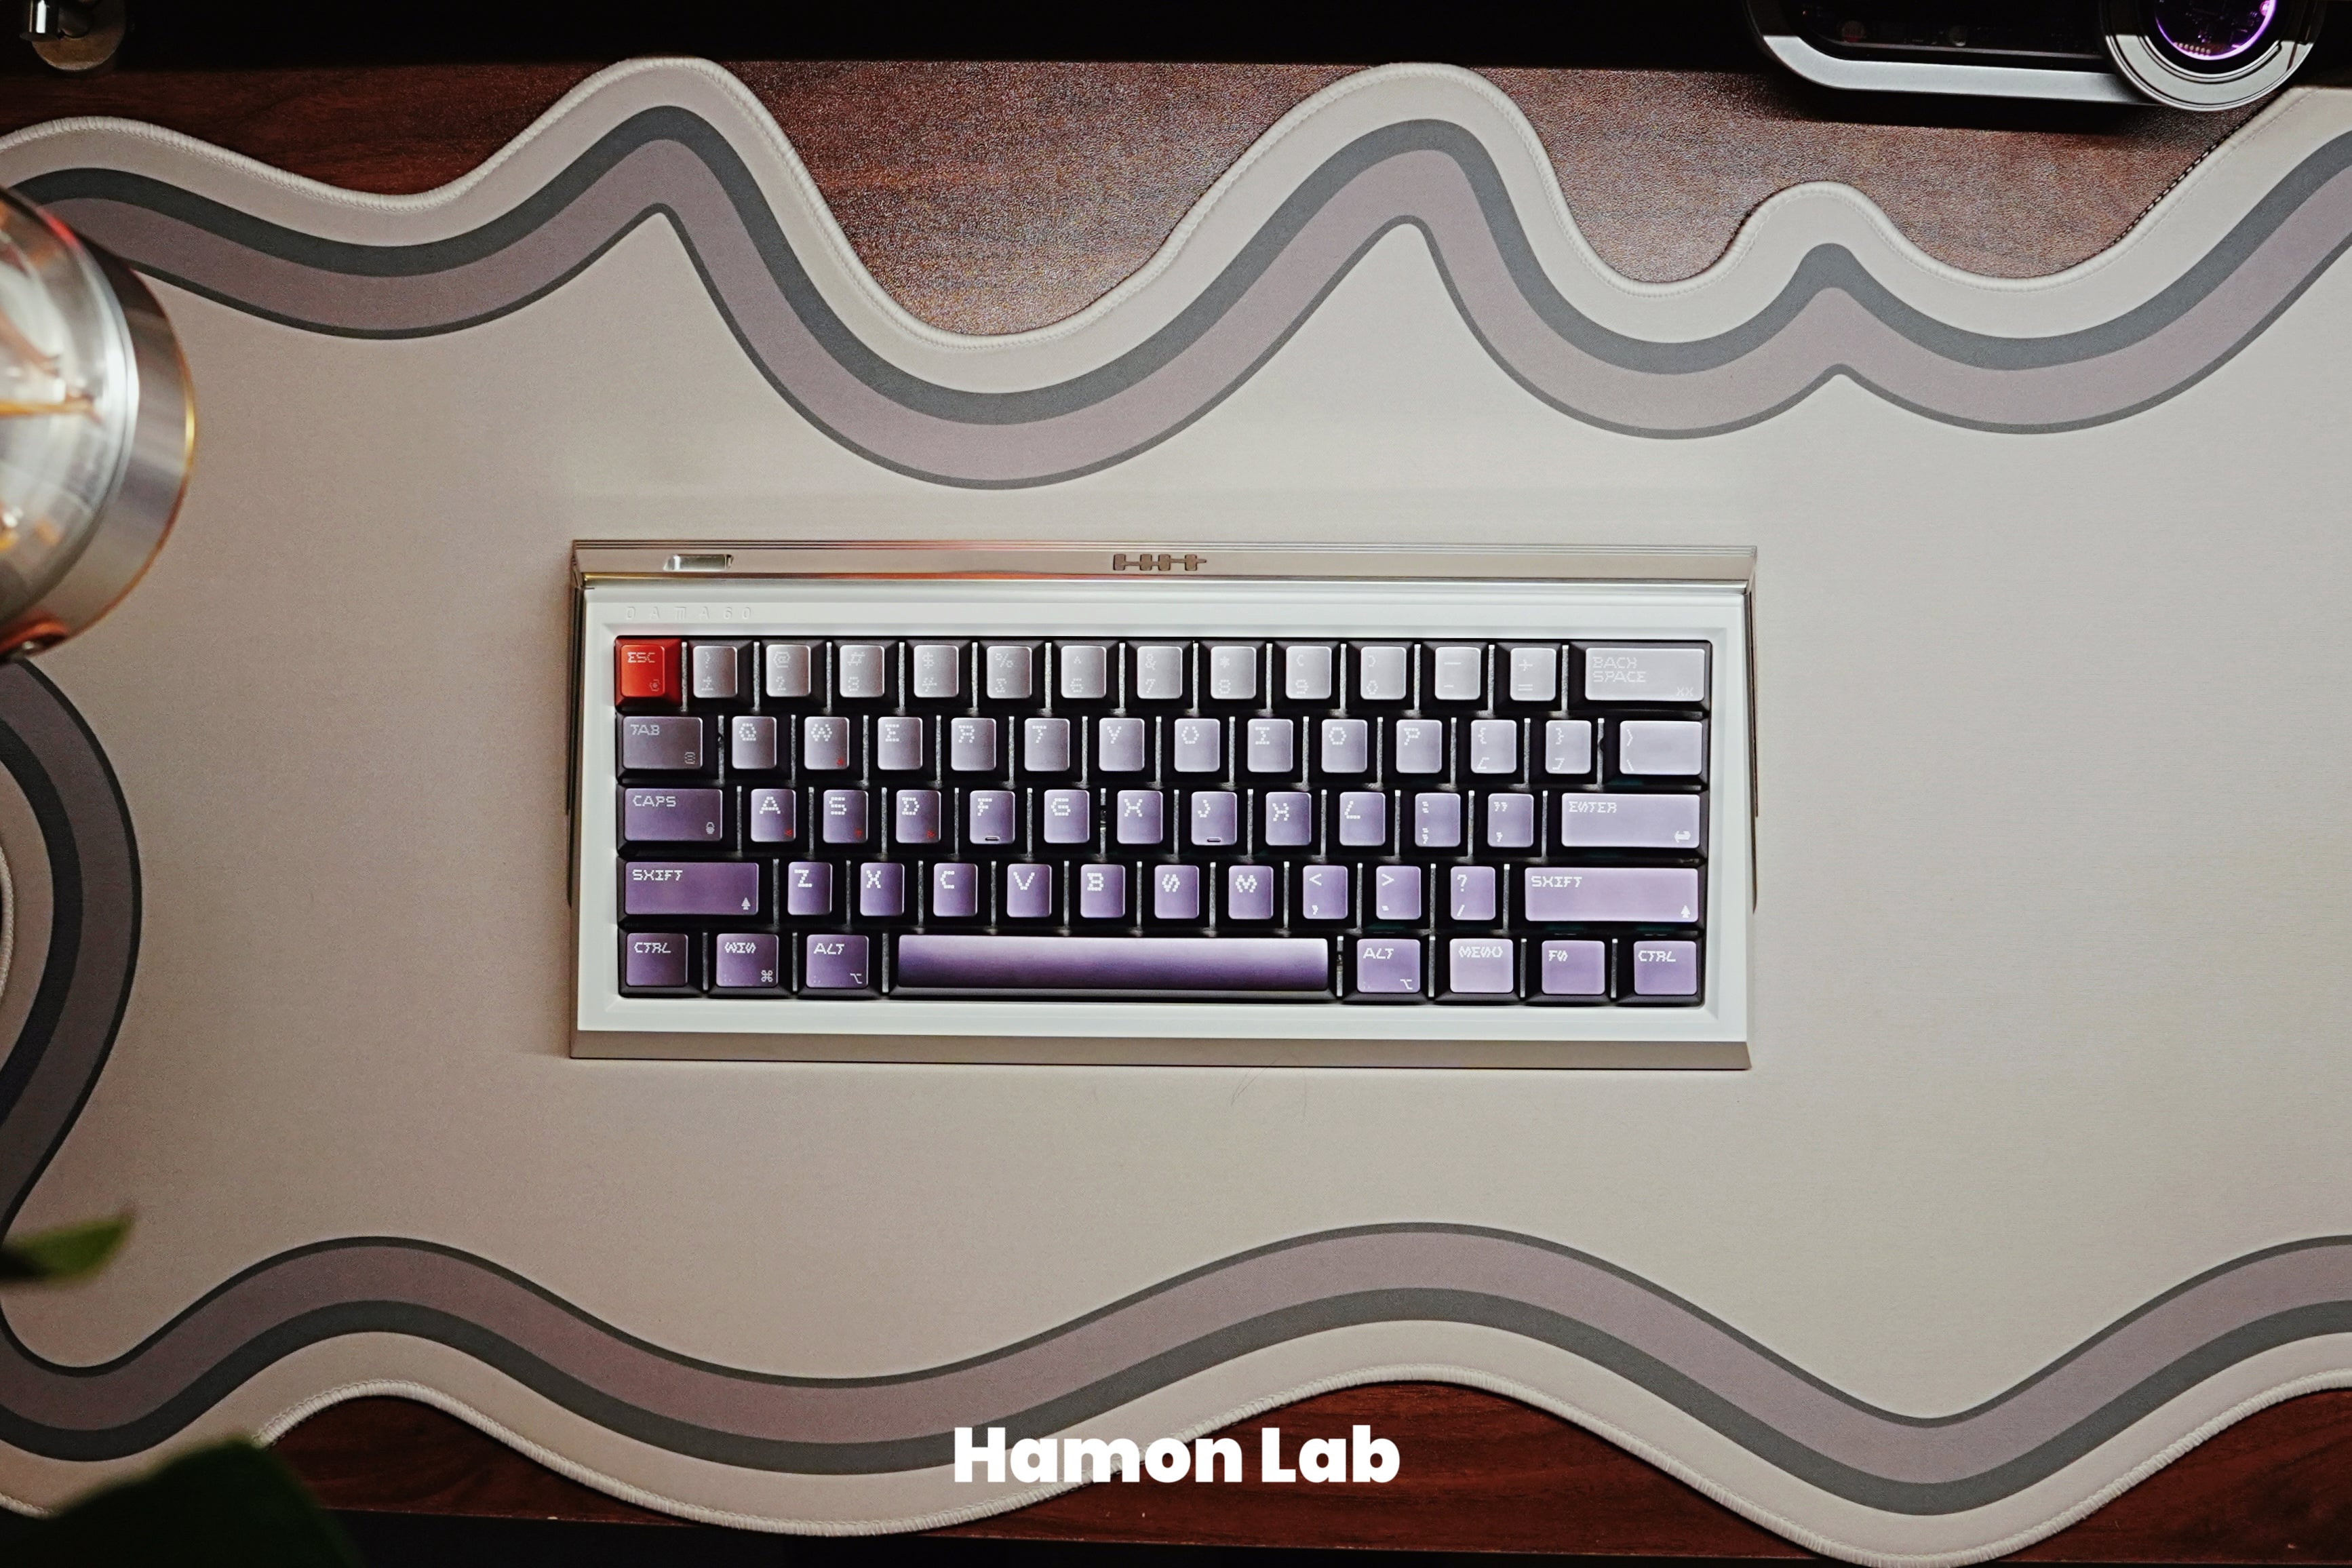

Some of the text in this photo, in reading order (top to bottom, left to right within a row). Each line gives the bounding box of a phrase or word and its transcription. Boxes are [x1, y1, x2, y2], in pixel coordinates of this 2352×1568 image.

[627, 652, 656, 663] ESC
[1070, 678, 1084, 693] 6
[1145, 678, 1156, 693] 7
[1592, 671, 1647, 683] SPACE
[630, 724, 660, 736] TAB
[739, 723, 757, 741] Q
[810, 724, 832, 741] W
[884, 724, 899, 741] E
[958, 725, 975, 743] R
[1032, 725, 1047, 743] T
[1107, 726, 1122, 744] Y
[1181, 726, 1200, 745] U
[1255, 726, 1270, 745] I
[1404, 727, 1421, 745] P
[633, 795, 676, 807] CAPS
[759, 796, 781, 814] A
[829, 796, 847, 815] S
[901, 797, 920, 815] D
[977, 798, 992, 817] F
[1051, 798, 1071, 816] G
[1197, 800, 1211, 818] J
[1344, 800, 1361, 819] L
[1568, 801, 1617, 813] ENTER
[631, 869, 684, 881] SHIFT
[793, 869, 812, 887] Z
[866, 870, 882, 888] X
[940, 870, 955, 889] C
[1013, 871, 1036, 890] V
[1086, 872, 1104, 891] B
[1457, 874, 1468, 892] ?
[1530, 876, 1583, 888] SHIFT
[633, 942, 671, 953] CTRL
[724, 942, 757, 953] WIN
[813, 943, 845, 954] ALT
[1363, 947, 1394, 959] ALT
[1638, 950, 1677, 962] CTRL
